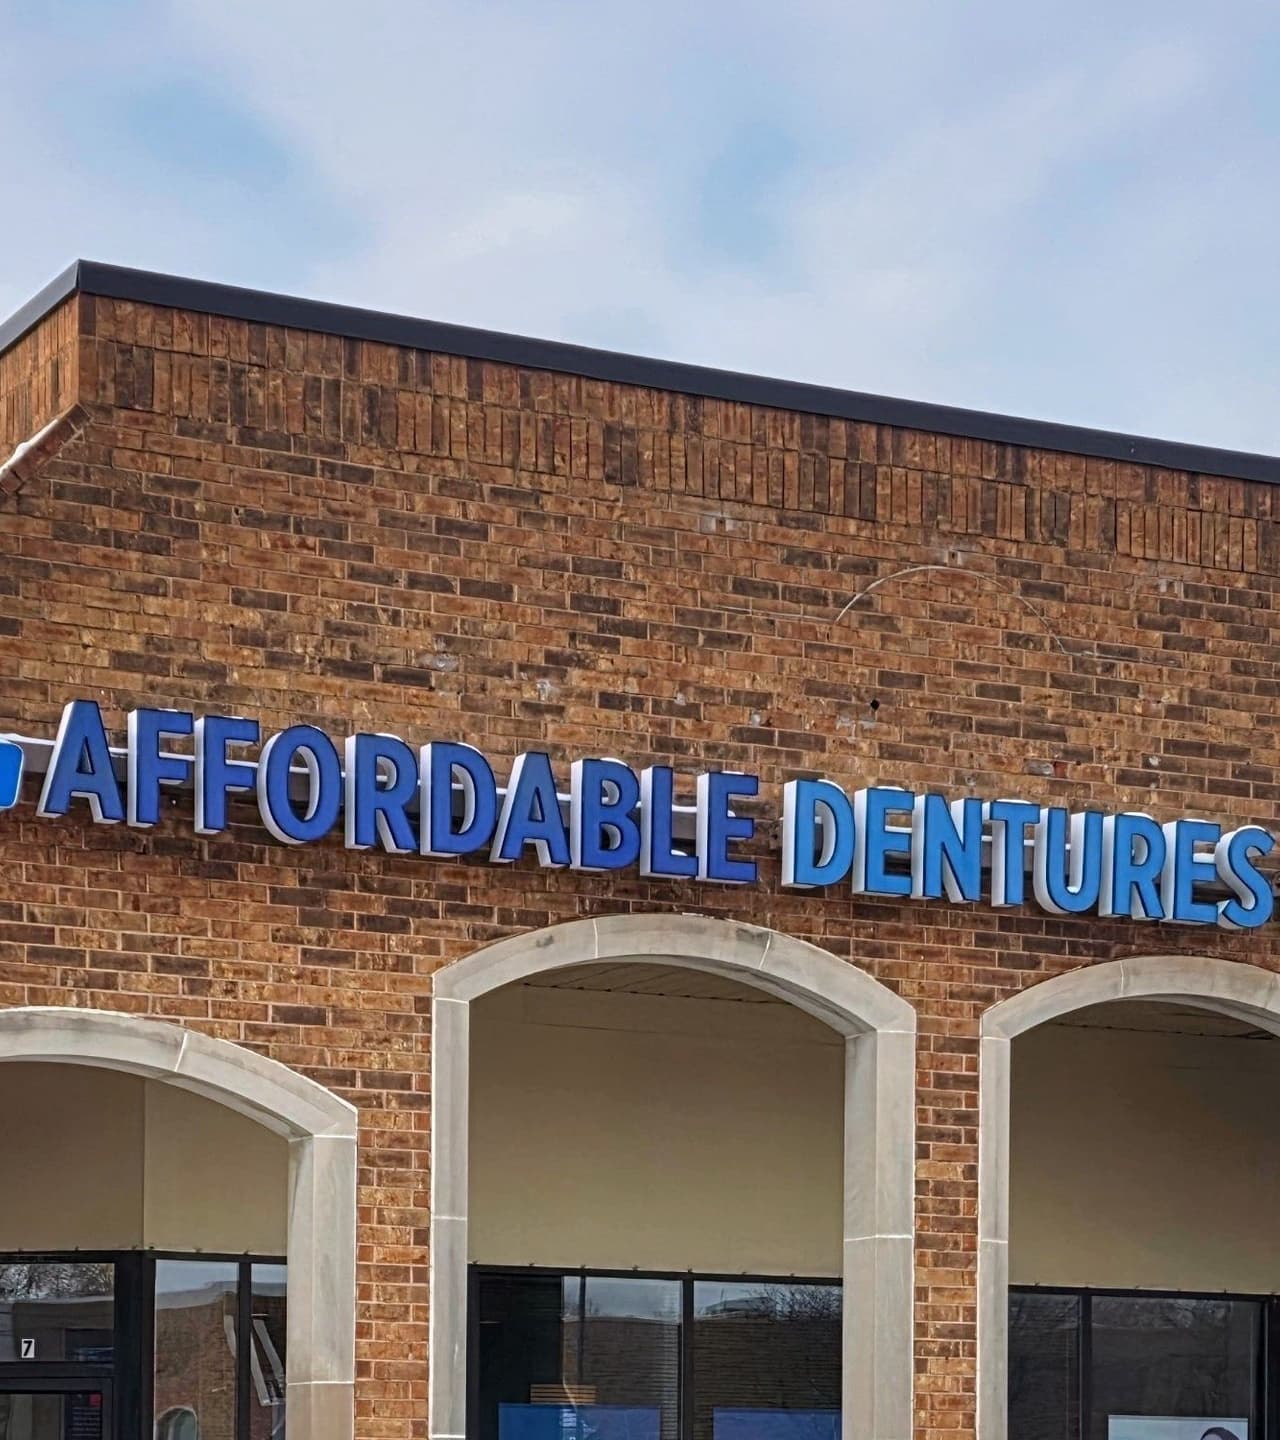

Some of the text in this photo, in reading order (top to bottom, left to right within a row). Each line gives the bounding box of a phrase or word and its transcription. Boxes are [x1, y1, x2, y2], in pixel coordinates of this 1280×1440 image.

[36, 699, 759, 884] AFFORDABLE
[781, 777, 1274, 930] DENTURES
[23, 1340, 33, 1357] 7
